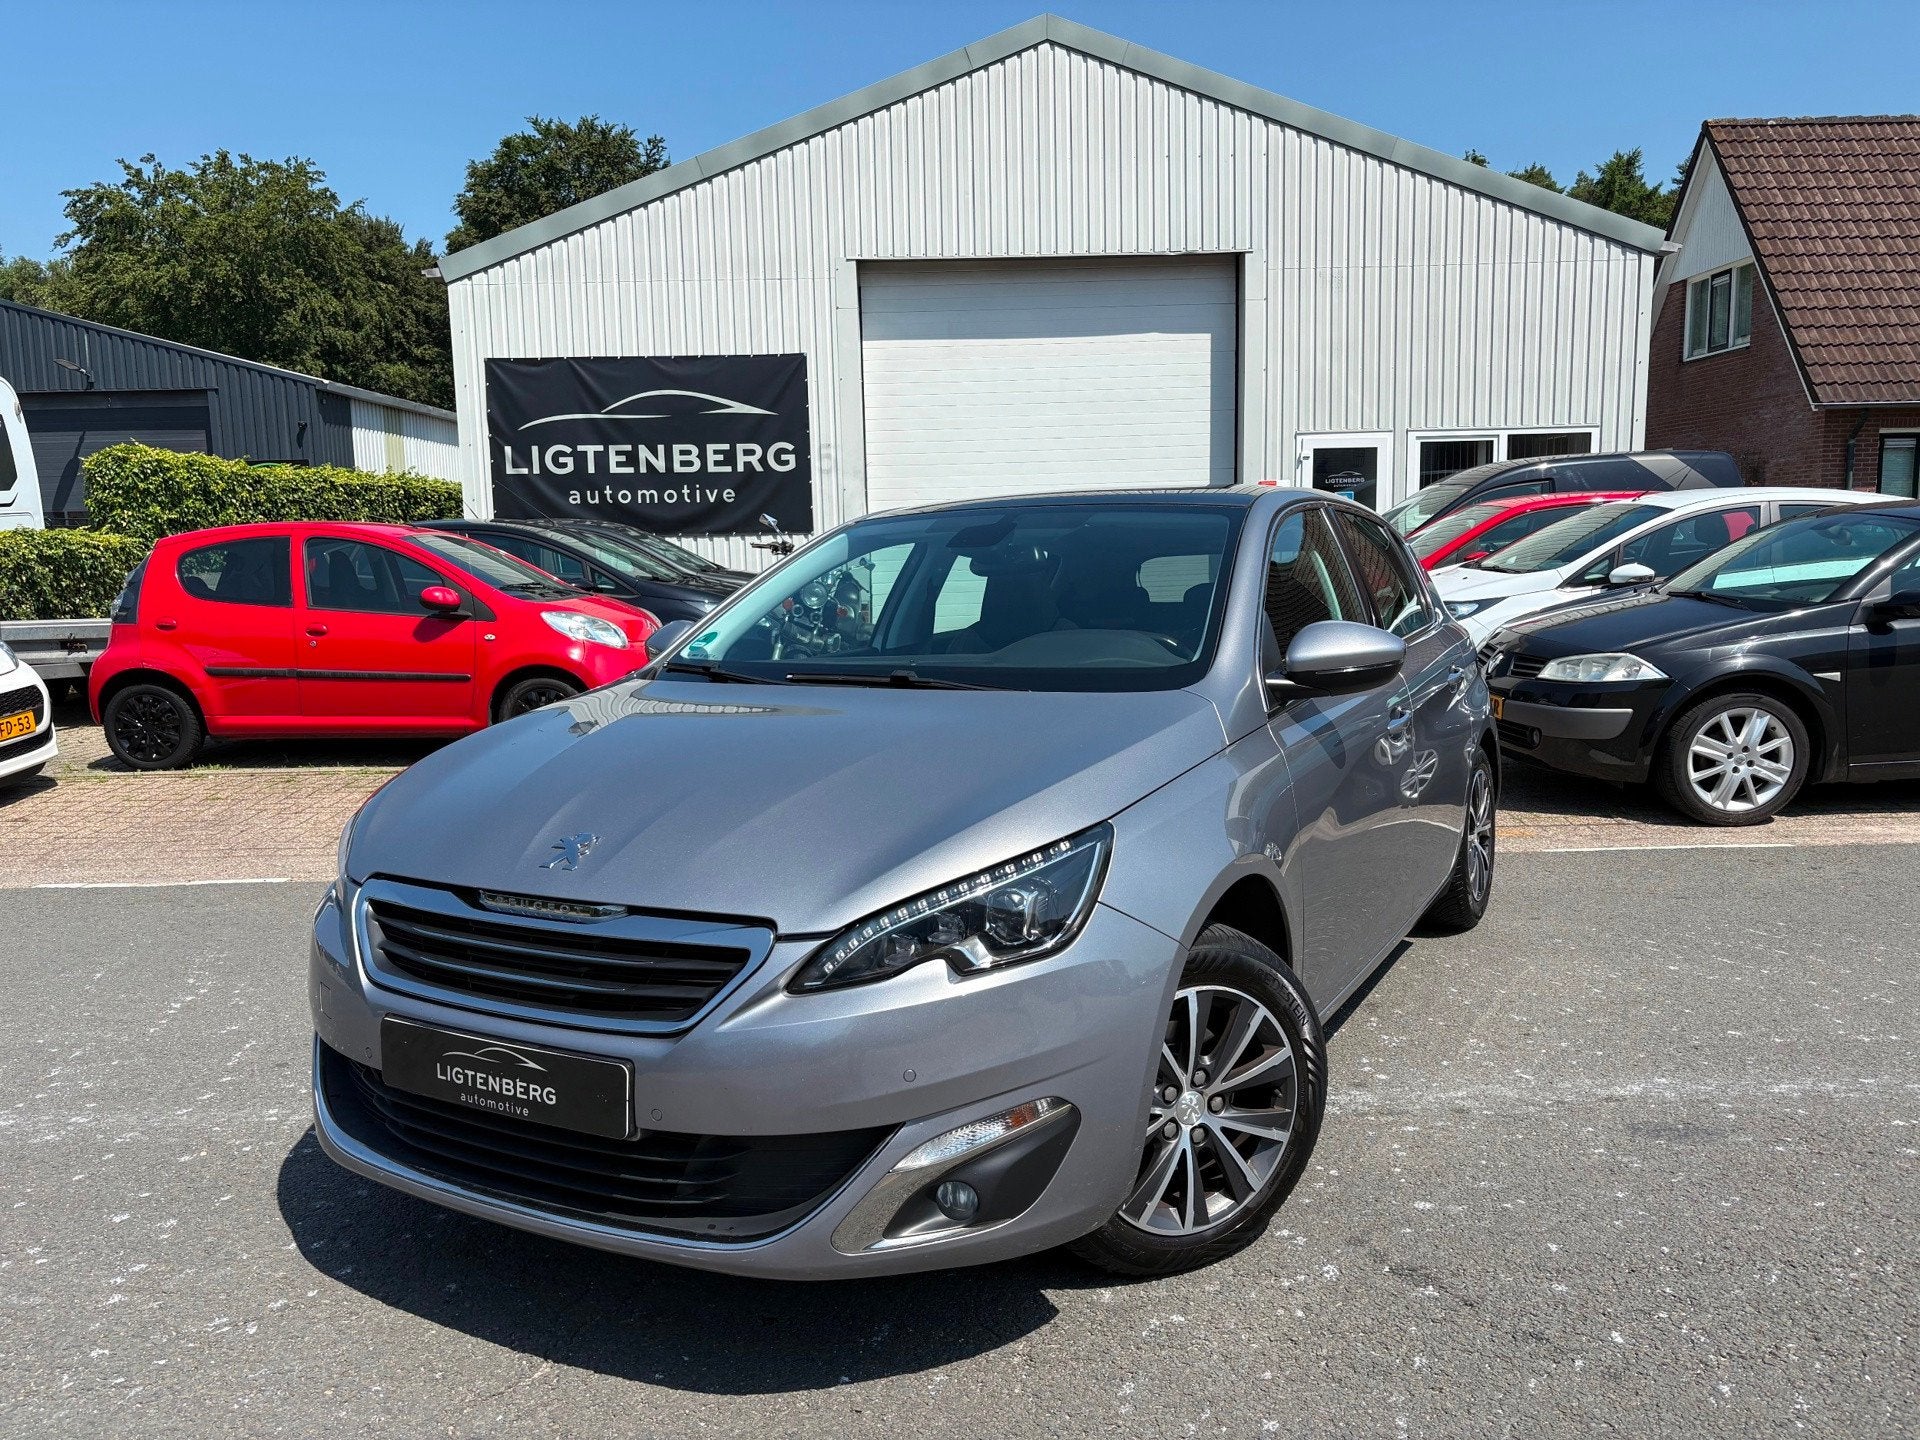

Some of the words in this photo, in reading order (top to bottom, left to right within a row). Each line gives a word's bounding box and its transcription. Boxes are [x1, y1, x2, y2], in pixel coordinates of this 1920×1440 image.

[504, 442, 797, 475] LIGTENBERG
[568, 484, 736, 504] automotive
[436, 1062, 557, 1105] LIGTENBERG
[460, 1092, 530, 1117] automotive
